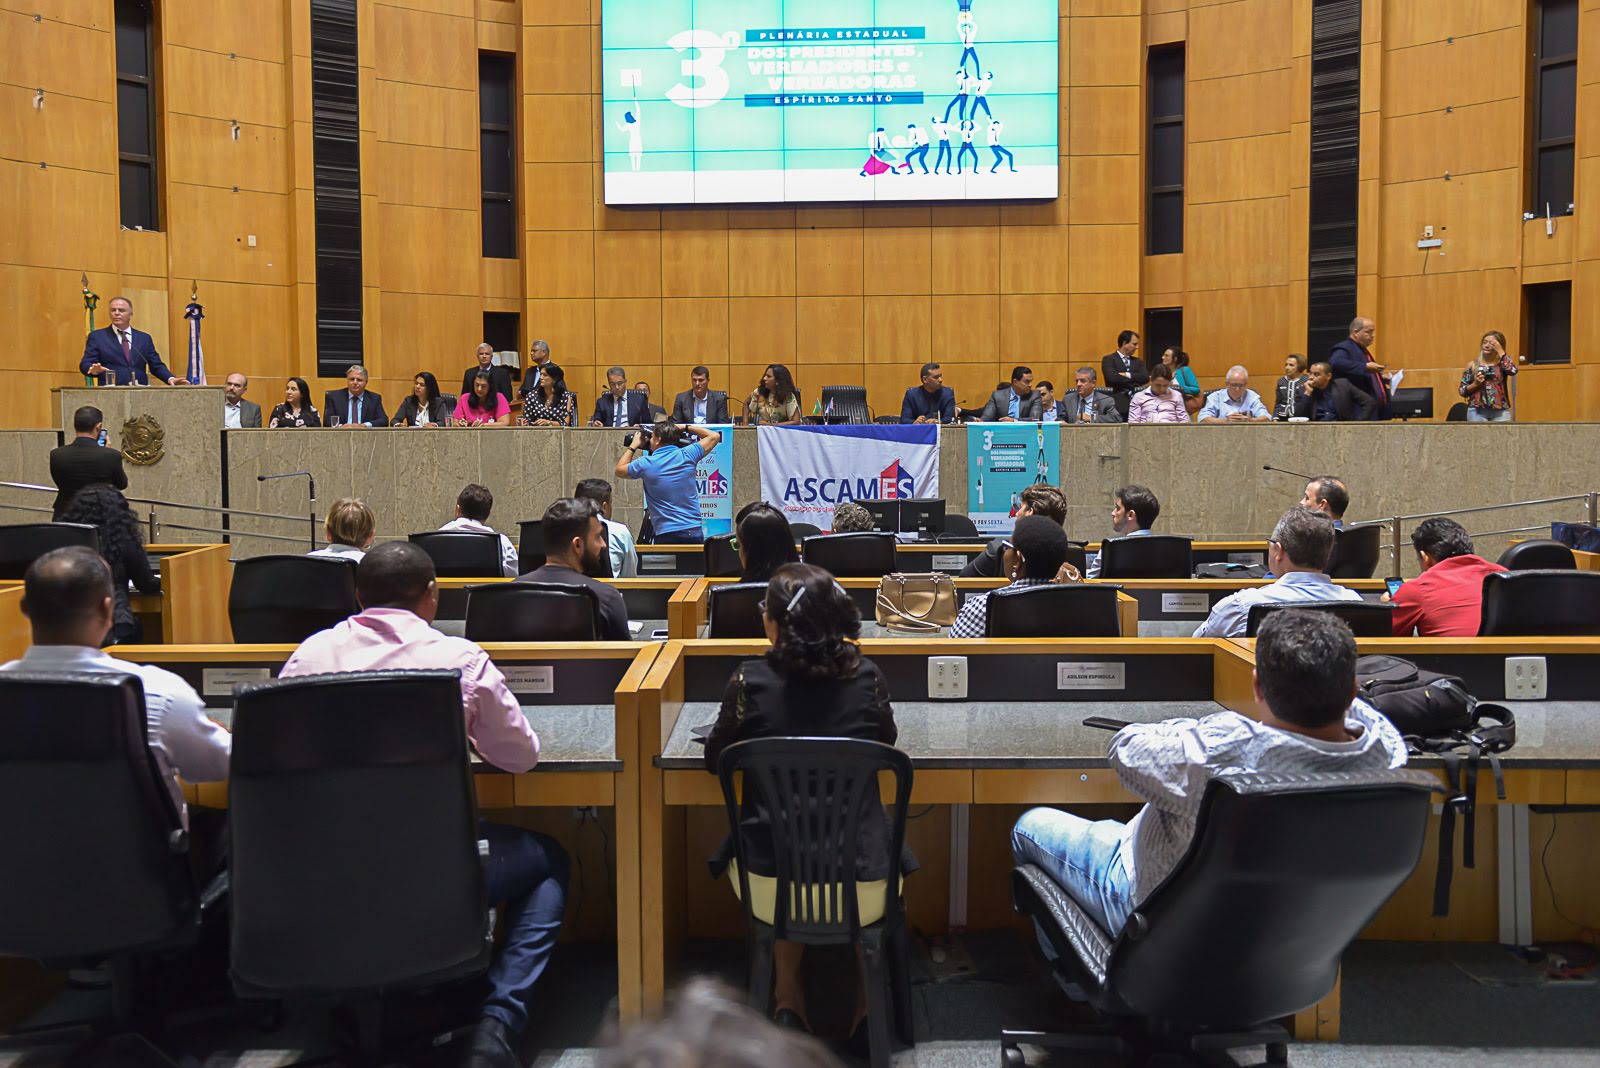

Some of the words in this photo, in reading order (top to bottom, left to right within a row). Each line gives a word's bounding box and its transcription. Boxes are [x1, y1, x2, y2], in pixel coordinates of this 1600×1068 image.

[760, 31, 829, 39] PLENÁRIA
[836, 30, 908, 38] ESTADUAL
[747, 47, 787, 59] DOS
[774, 95, 840, 104] ESPÍRITO
[847, 94, 893, 103] SANTO
[783, 477, 915, 503] ASCAMES
